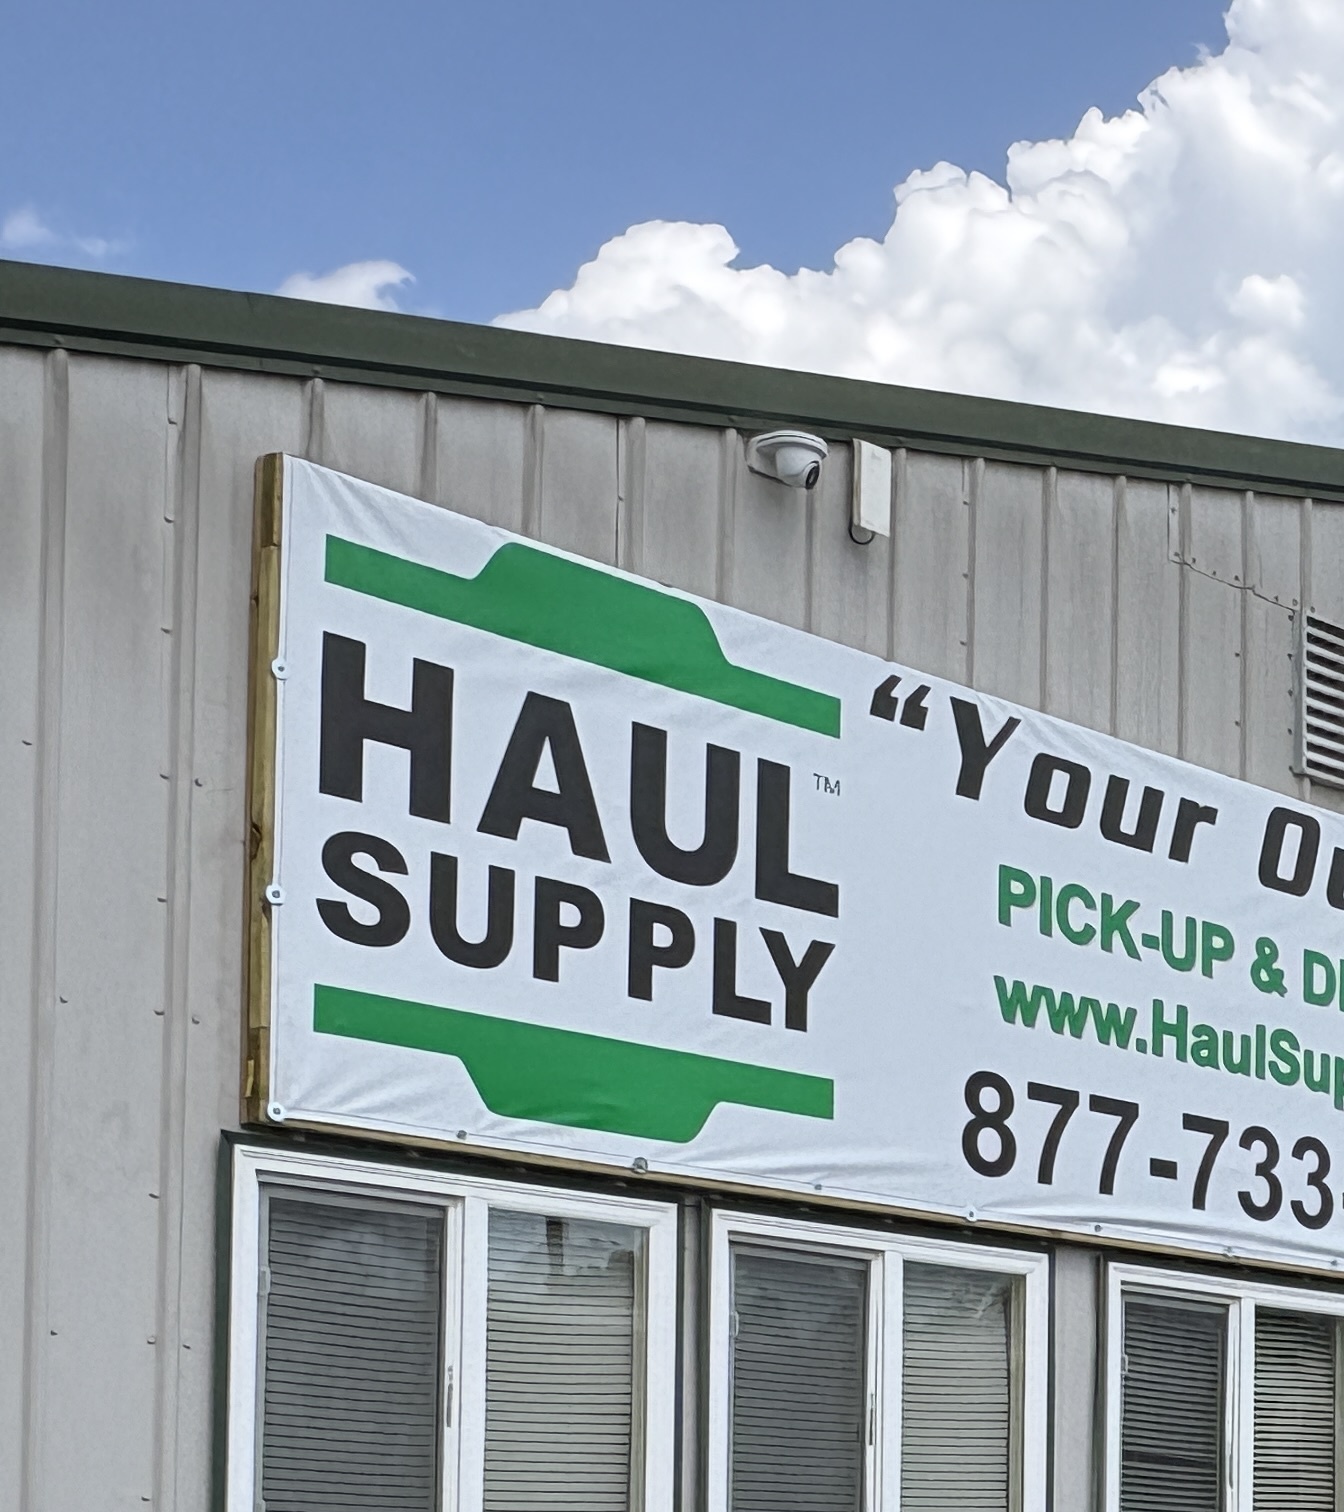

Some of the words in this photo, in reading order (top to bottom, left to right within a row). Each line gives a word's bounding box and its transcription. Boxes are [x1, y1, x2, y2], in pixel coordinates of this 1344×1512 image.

[318, 630, 840, 919] HAUL
[315, 830, 836, 1033] SUPPLY
[998, 864, 1235, 978] PICK-UP
[1250, 937, 1287, 997] &
